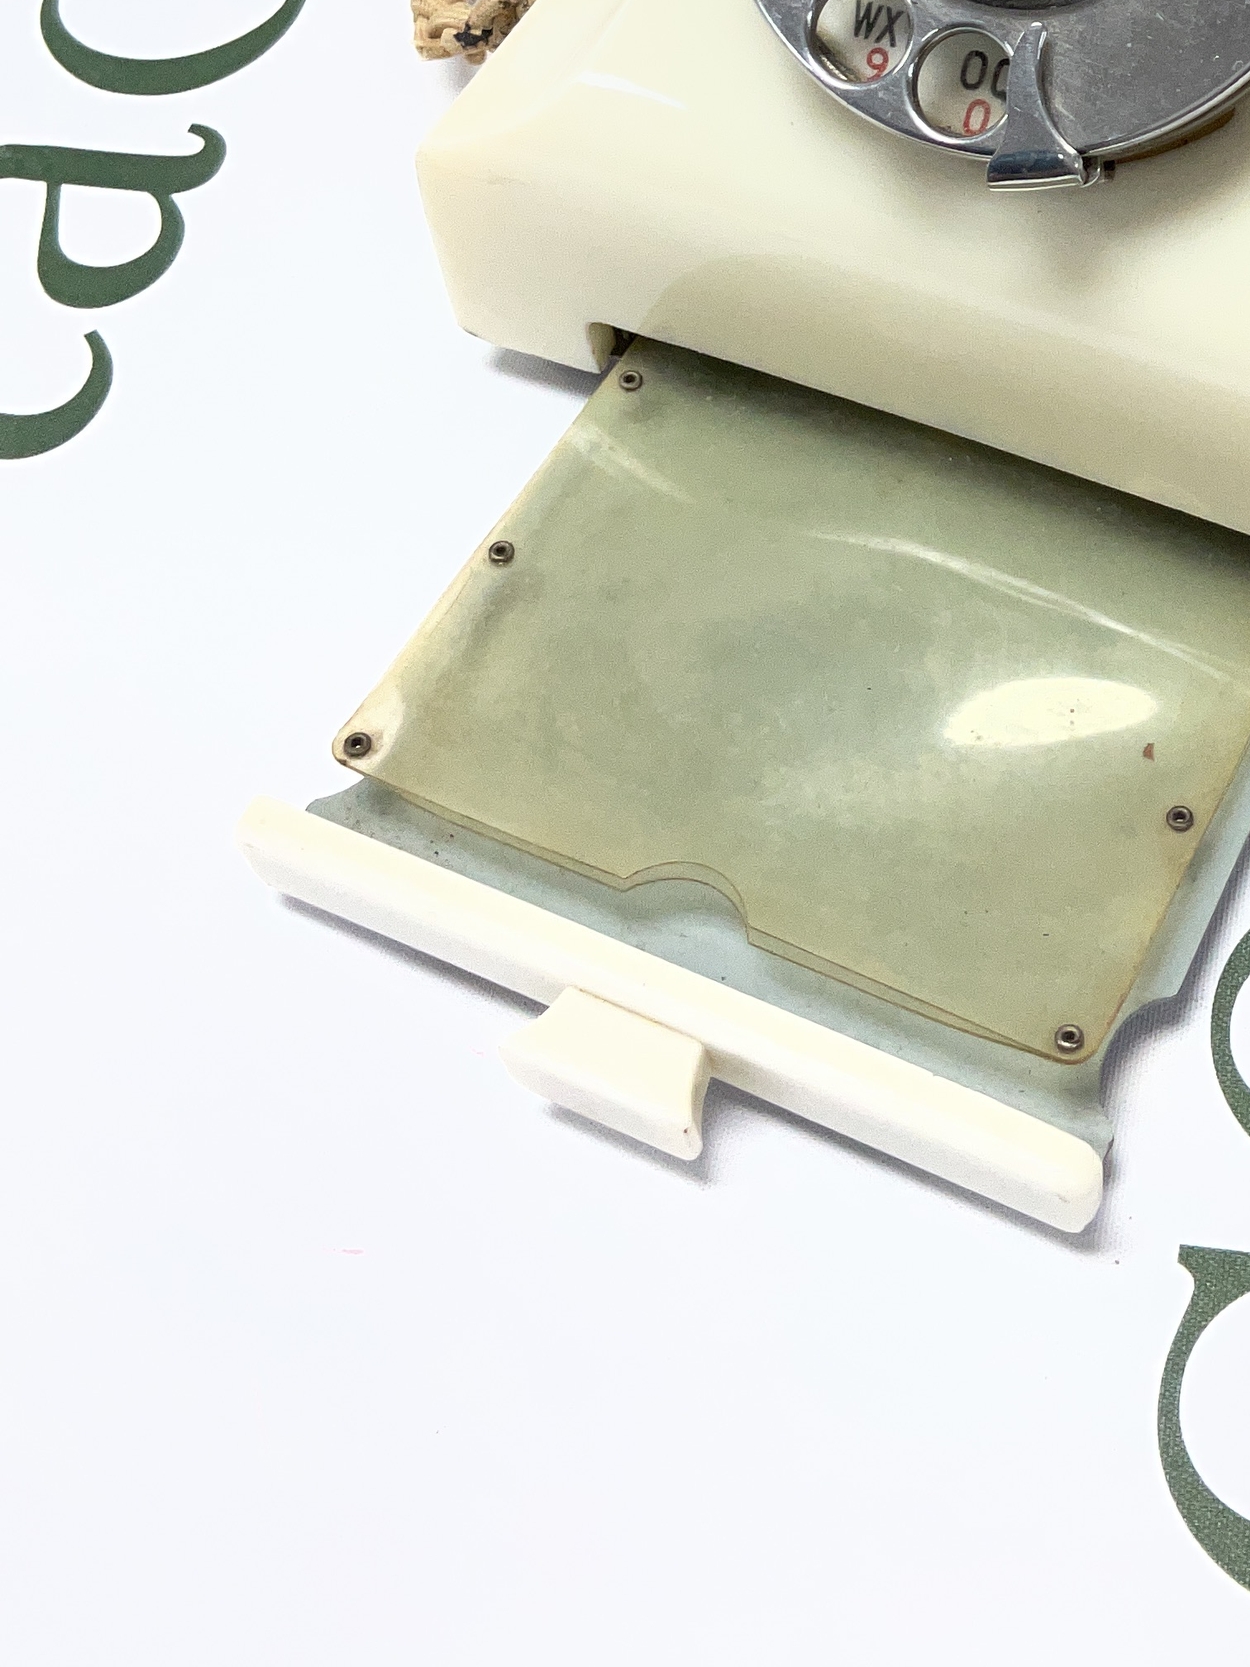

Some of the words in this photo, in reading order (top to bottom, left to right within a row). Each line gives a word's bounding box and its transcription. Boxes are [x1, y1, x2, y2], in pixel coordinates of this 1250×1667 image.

[853, 0, 904, 48] WX
[866, 47, 889, 82] 9
[962, 98, 992, 136] 0
